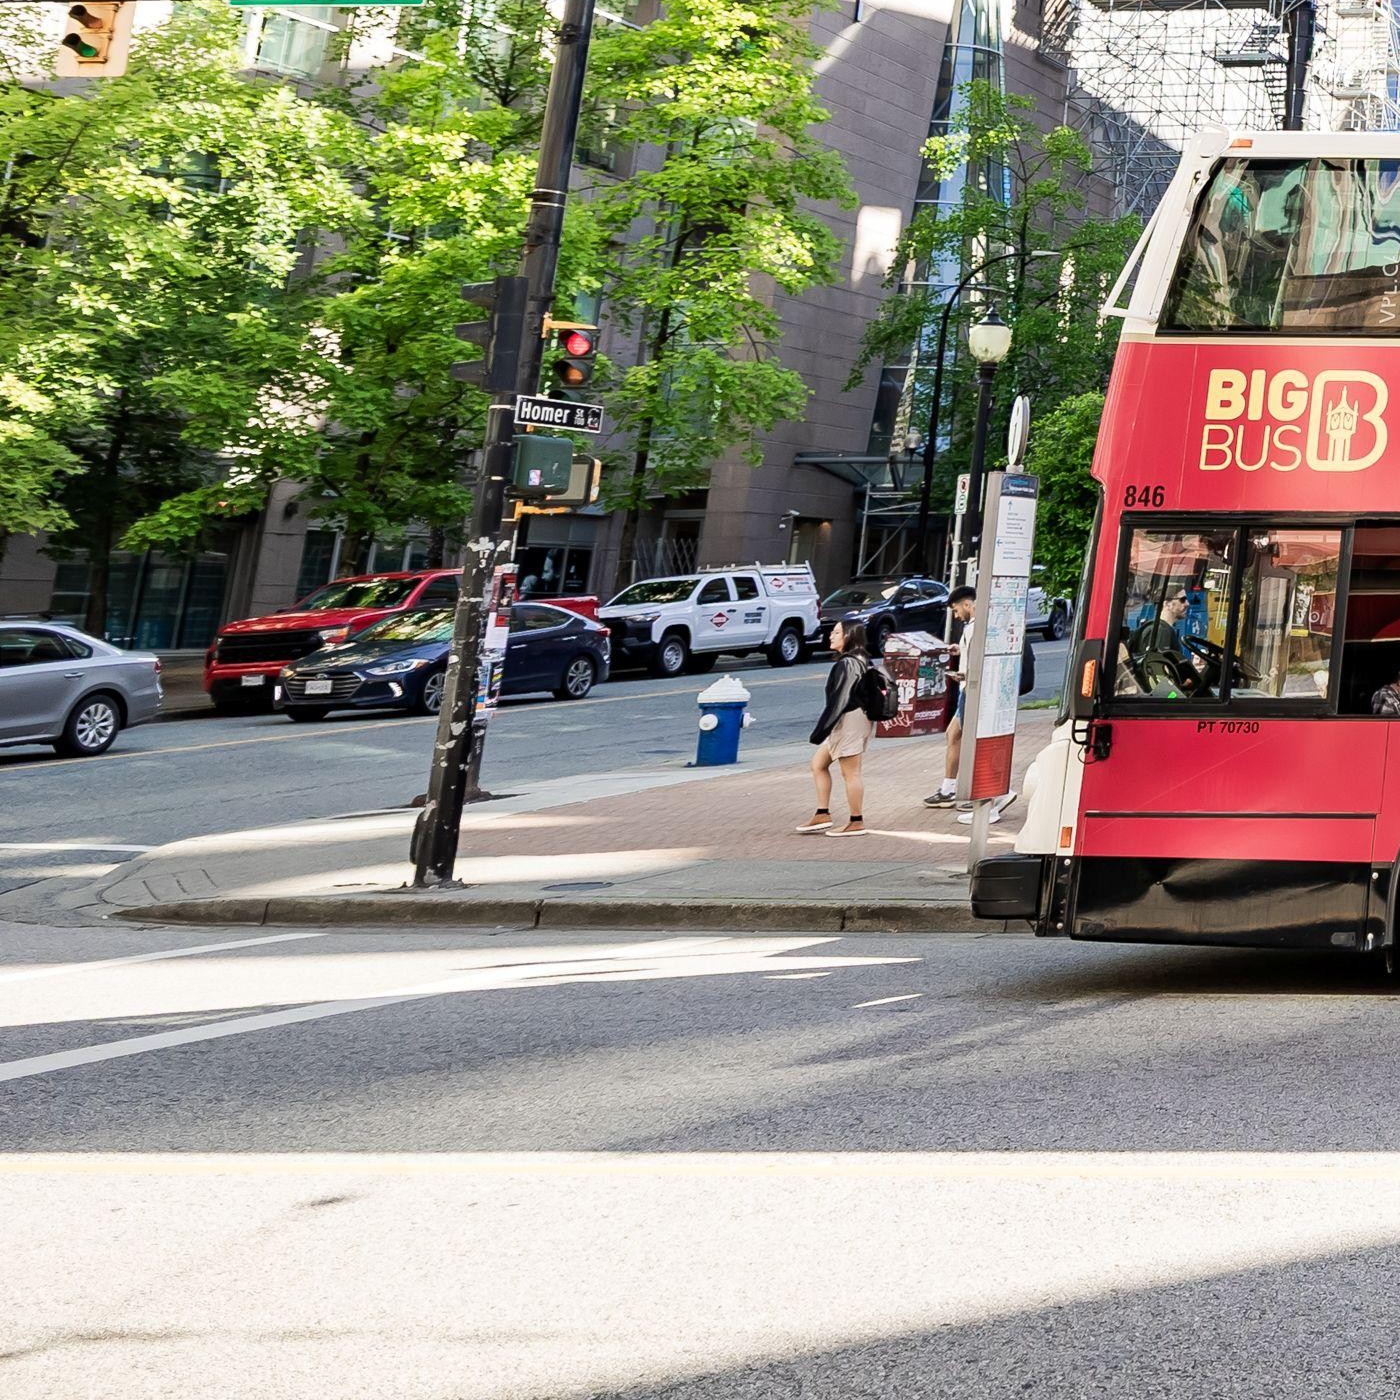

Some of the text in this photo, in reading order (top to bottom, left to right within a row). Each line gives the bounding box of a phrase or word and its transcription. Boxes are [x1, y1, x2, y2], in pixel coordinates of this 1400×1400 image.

[1205, 368, 1309, 422] BIG
[520, 401, 571, 424] Homer
[1199, 424, 1302, 472] BUS
[1123, 485, 1165, 508] 846
[1197, 721, 1260, 734] PT 70730
